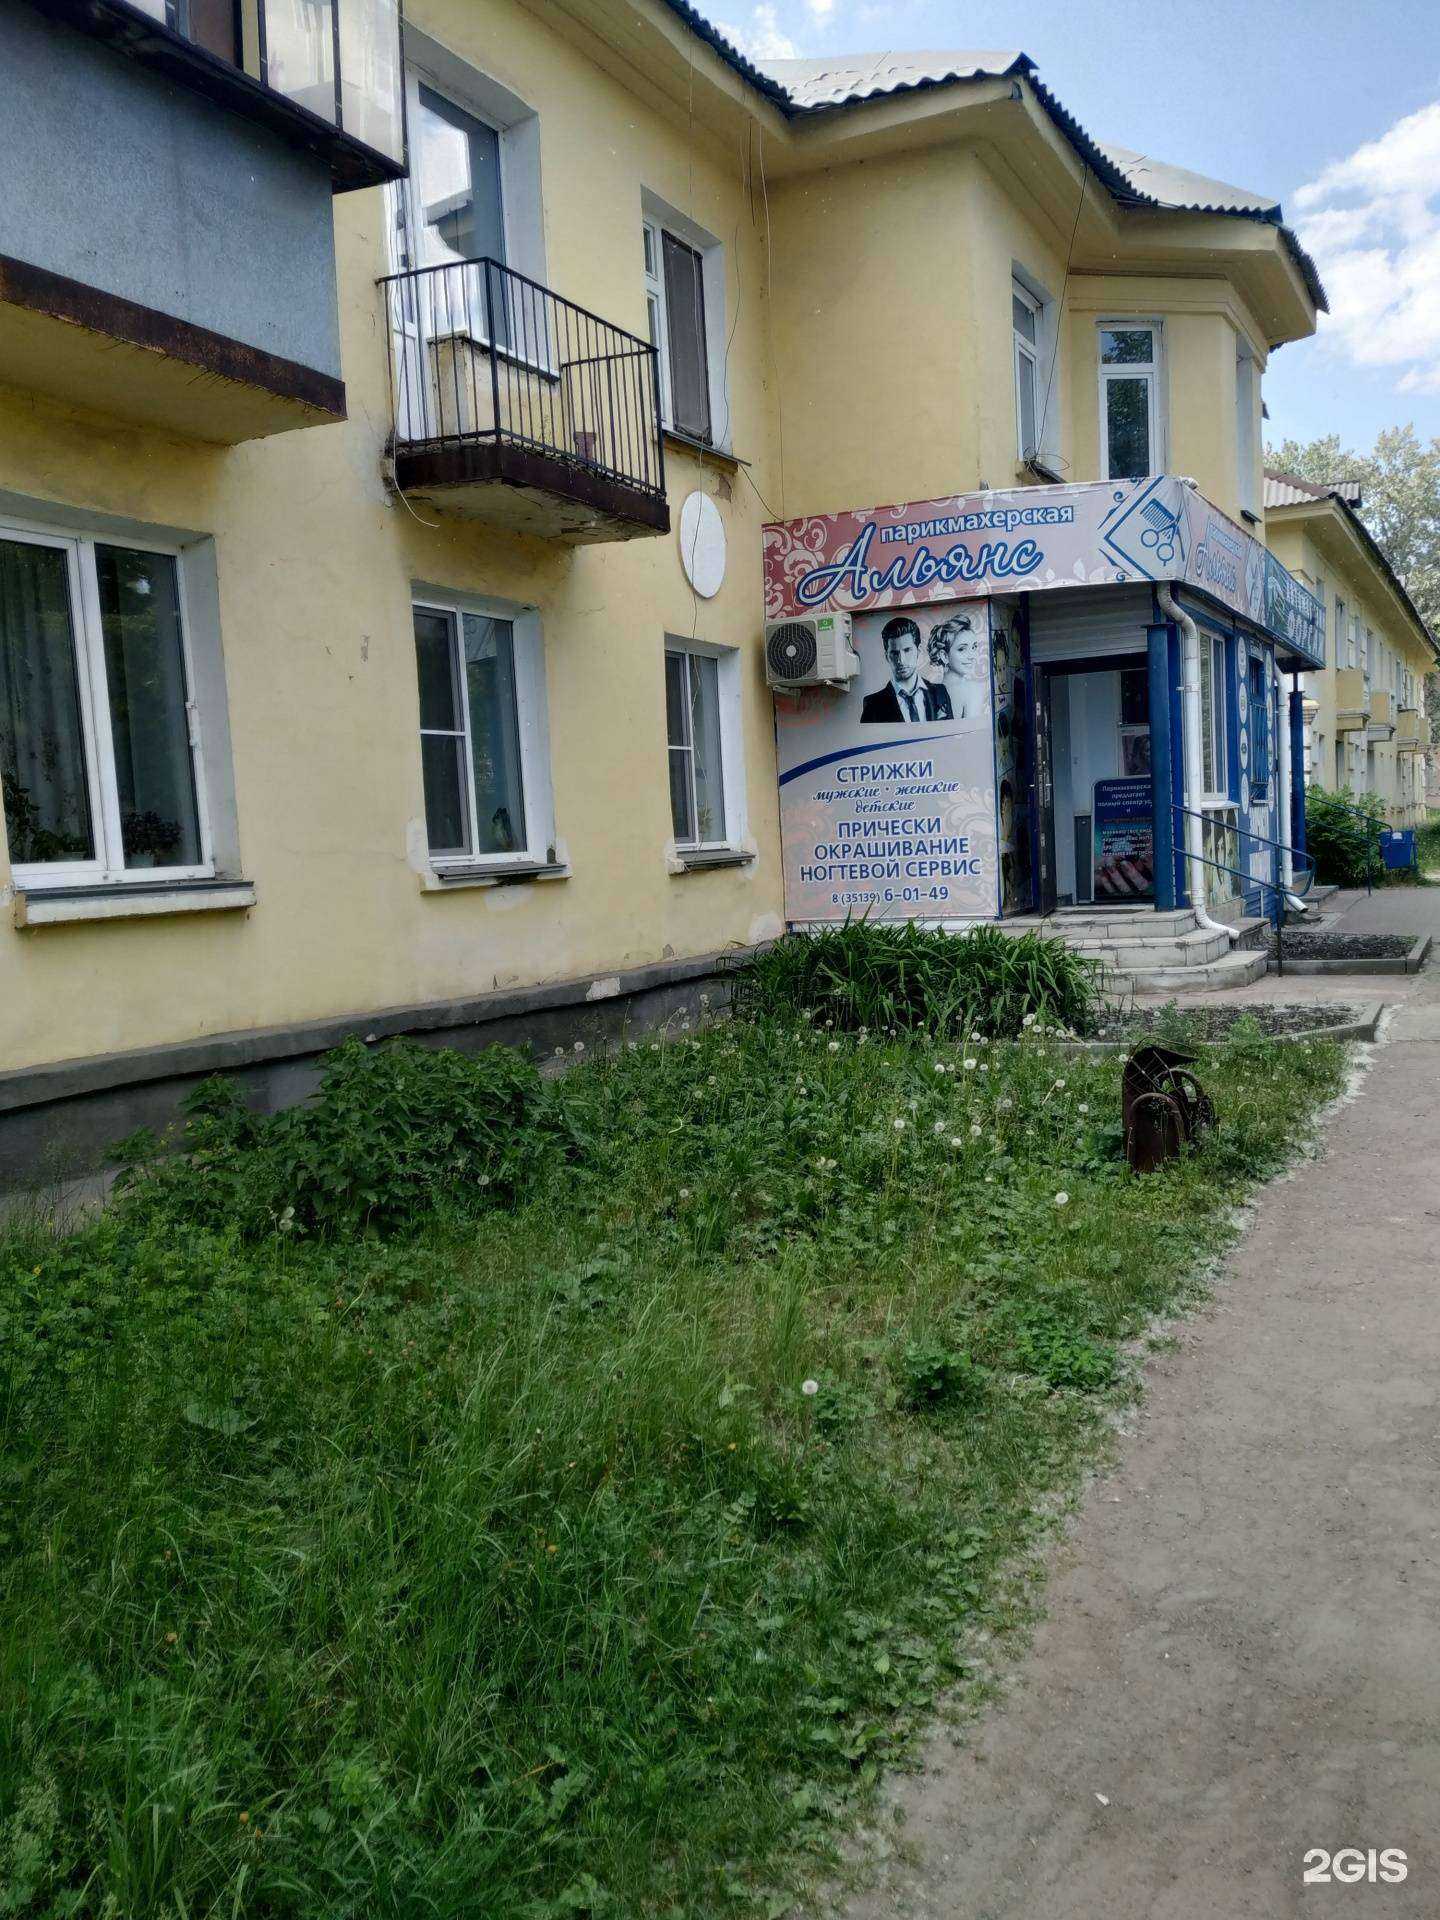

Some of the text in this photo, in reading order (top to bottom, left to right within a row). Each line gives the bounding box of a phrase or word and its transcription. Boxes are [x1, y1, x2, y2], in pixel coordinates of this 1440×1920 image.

[880, 505, 1073, 545] парикмахерская
[796, 522, 1044, 606] Альянс
[836, 760, 933, 782] СТРИЖКИ
[813, 781, 960, 802] мужские женские
[855, 800, 915, 813] детские
[838, 817, 941, 838] ПРИЧЕСКИ
[814, 837, 969, 860] ОКРАШИВАНИЕ
[800, 859, 981, 881] НОГТЕВОЙ СЕРВИС
[832, 886, 948, 904] 8 (35139) 6-01-49
